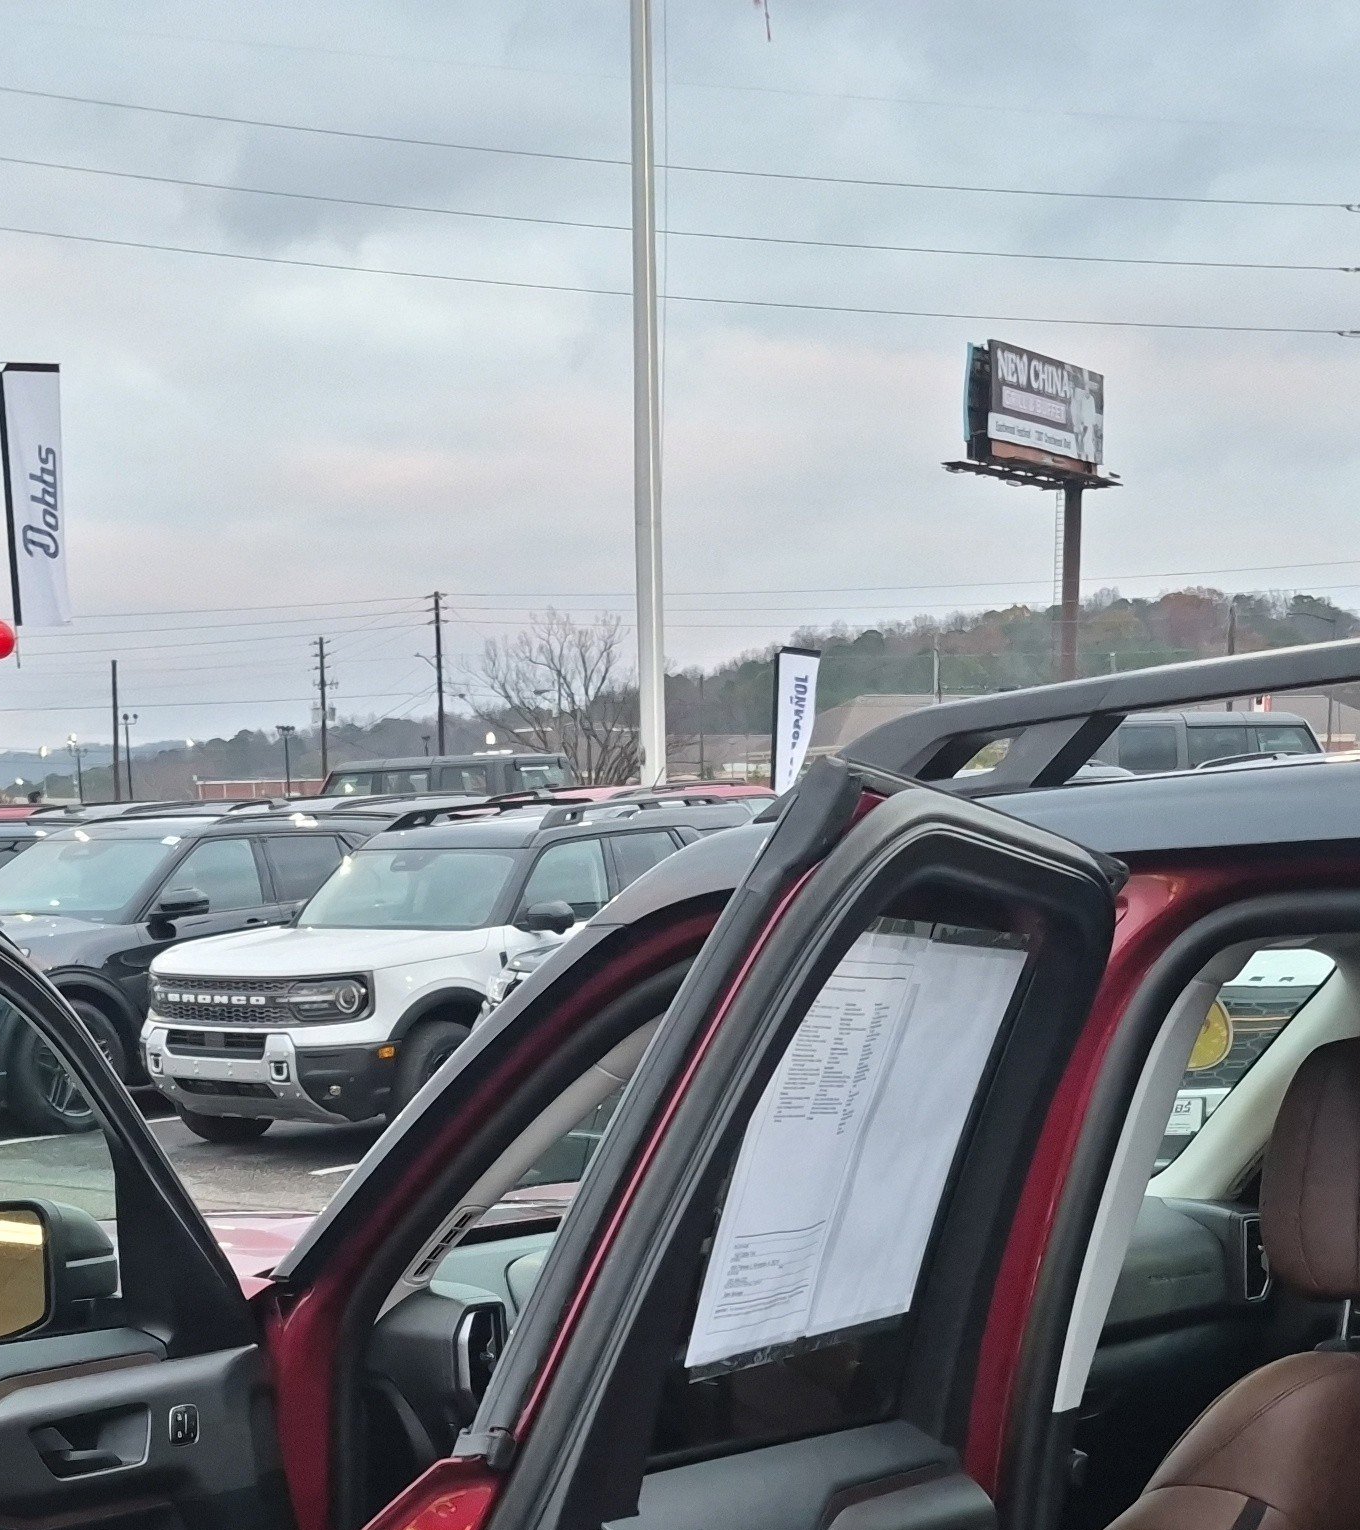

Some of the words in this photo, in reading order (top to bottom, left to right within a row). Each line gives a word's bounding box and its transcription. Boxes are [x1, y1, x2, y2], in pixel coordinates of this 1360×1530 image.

[997, 348, 1028, 387] NEW
[1030, 359, 1070, 398] CHINA
[22, 444, 60, 559] Dobbs
[166, 993, 267, 1005] BRONCO
